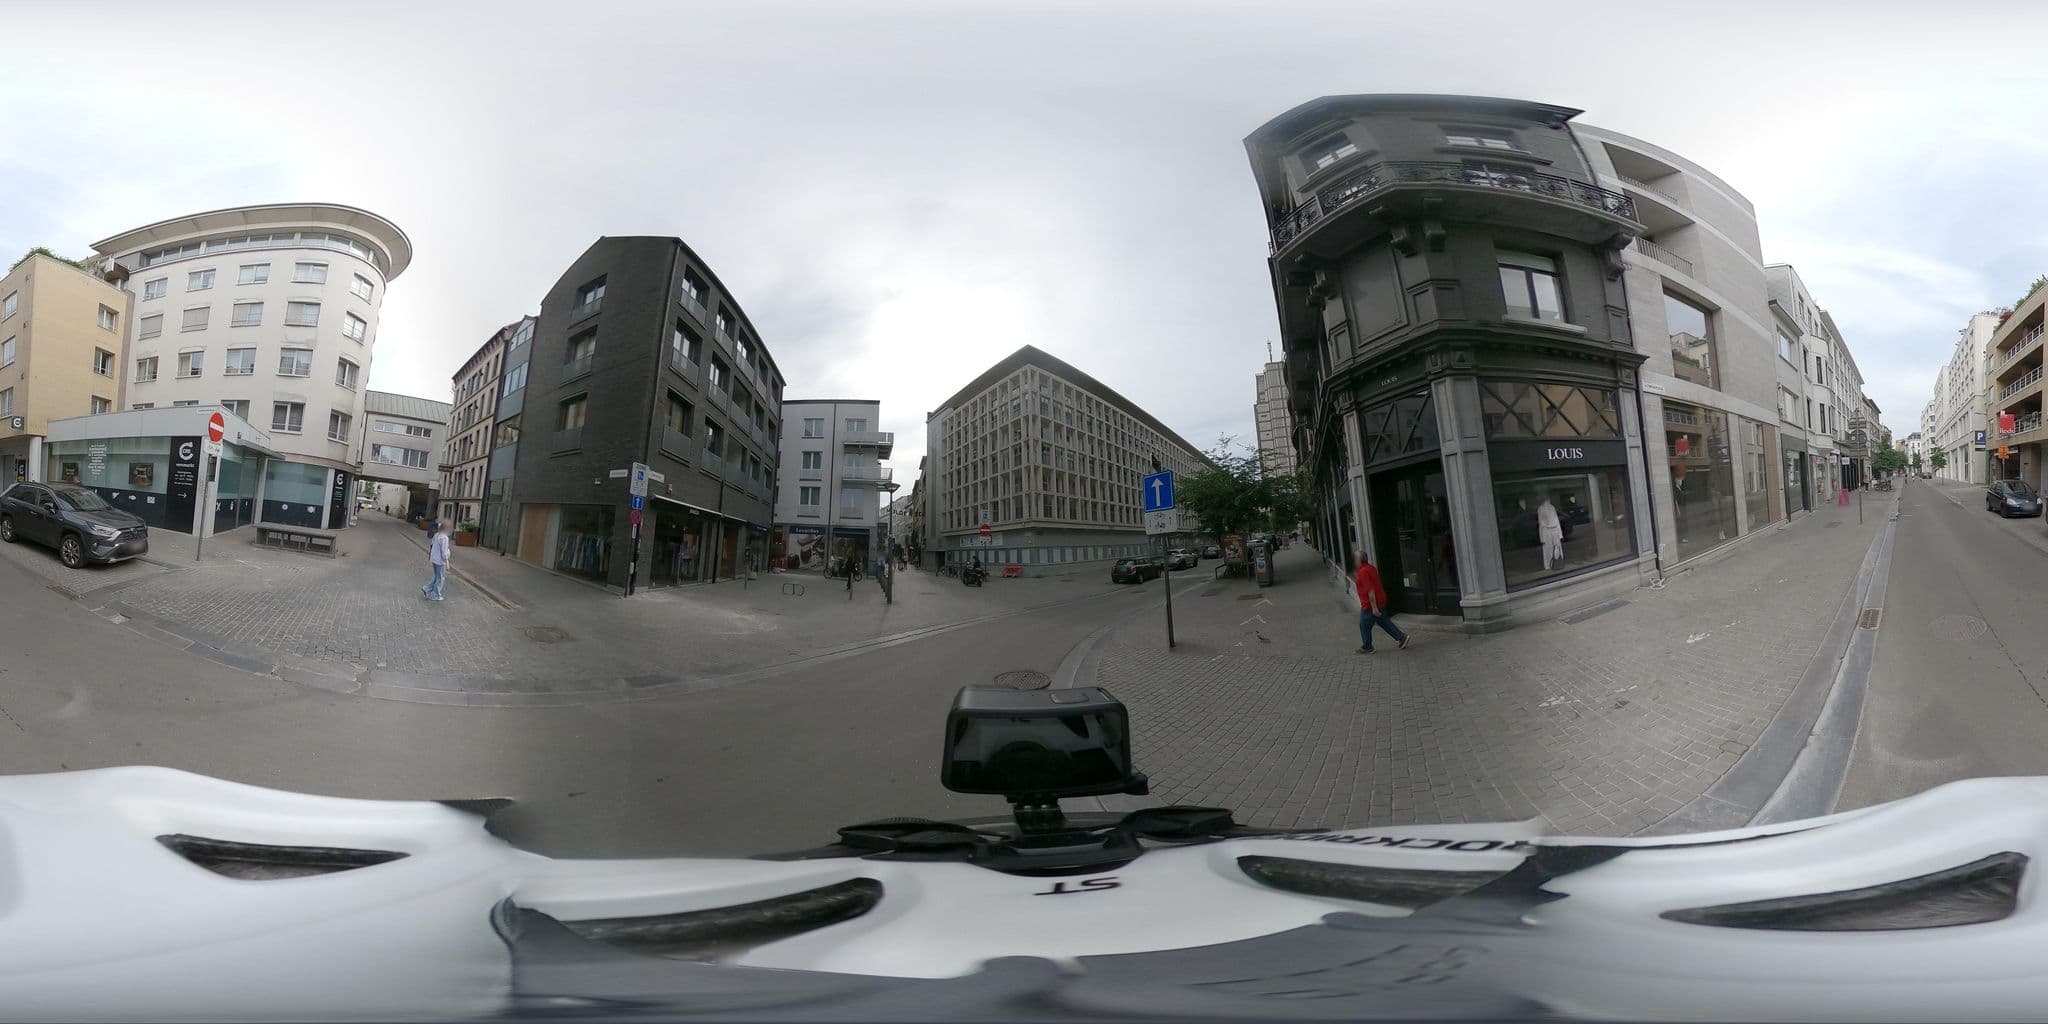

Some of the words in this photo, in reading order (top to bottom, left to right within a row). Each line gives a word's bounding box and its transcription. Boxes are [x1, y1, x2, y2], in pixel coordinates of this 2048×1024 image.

[1977, 432, 1984, 441] P
[1547, 447, 1583, 460] LOUIS
[1256, 834, 1530, 852] OCKRID
[1032, 876, 1123, 897] ST
